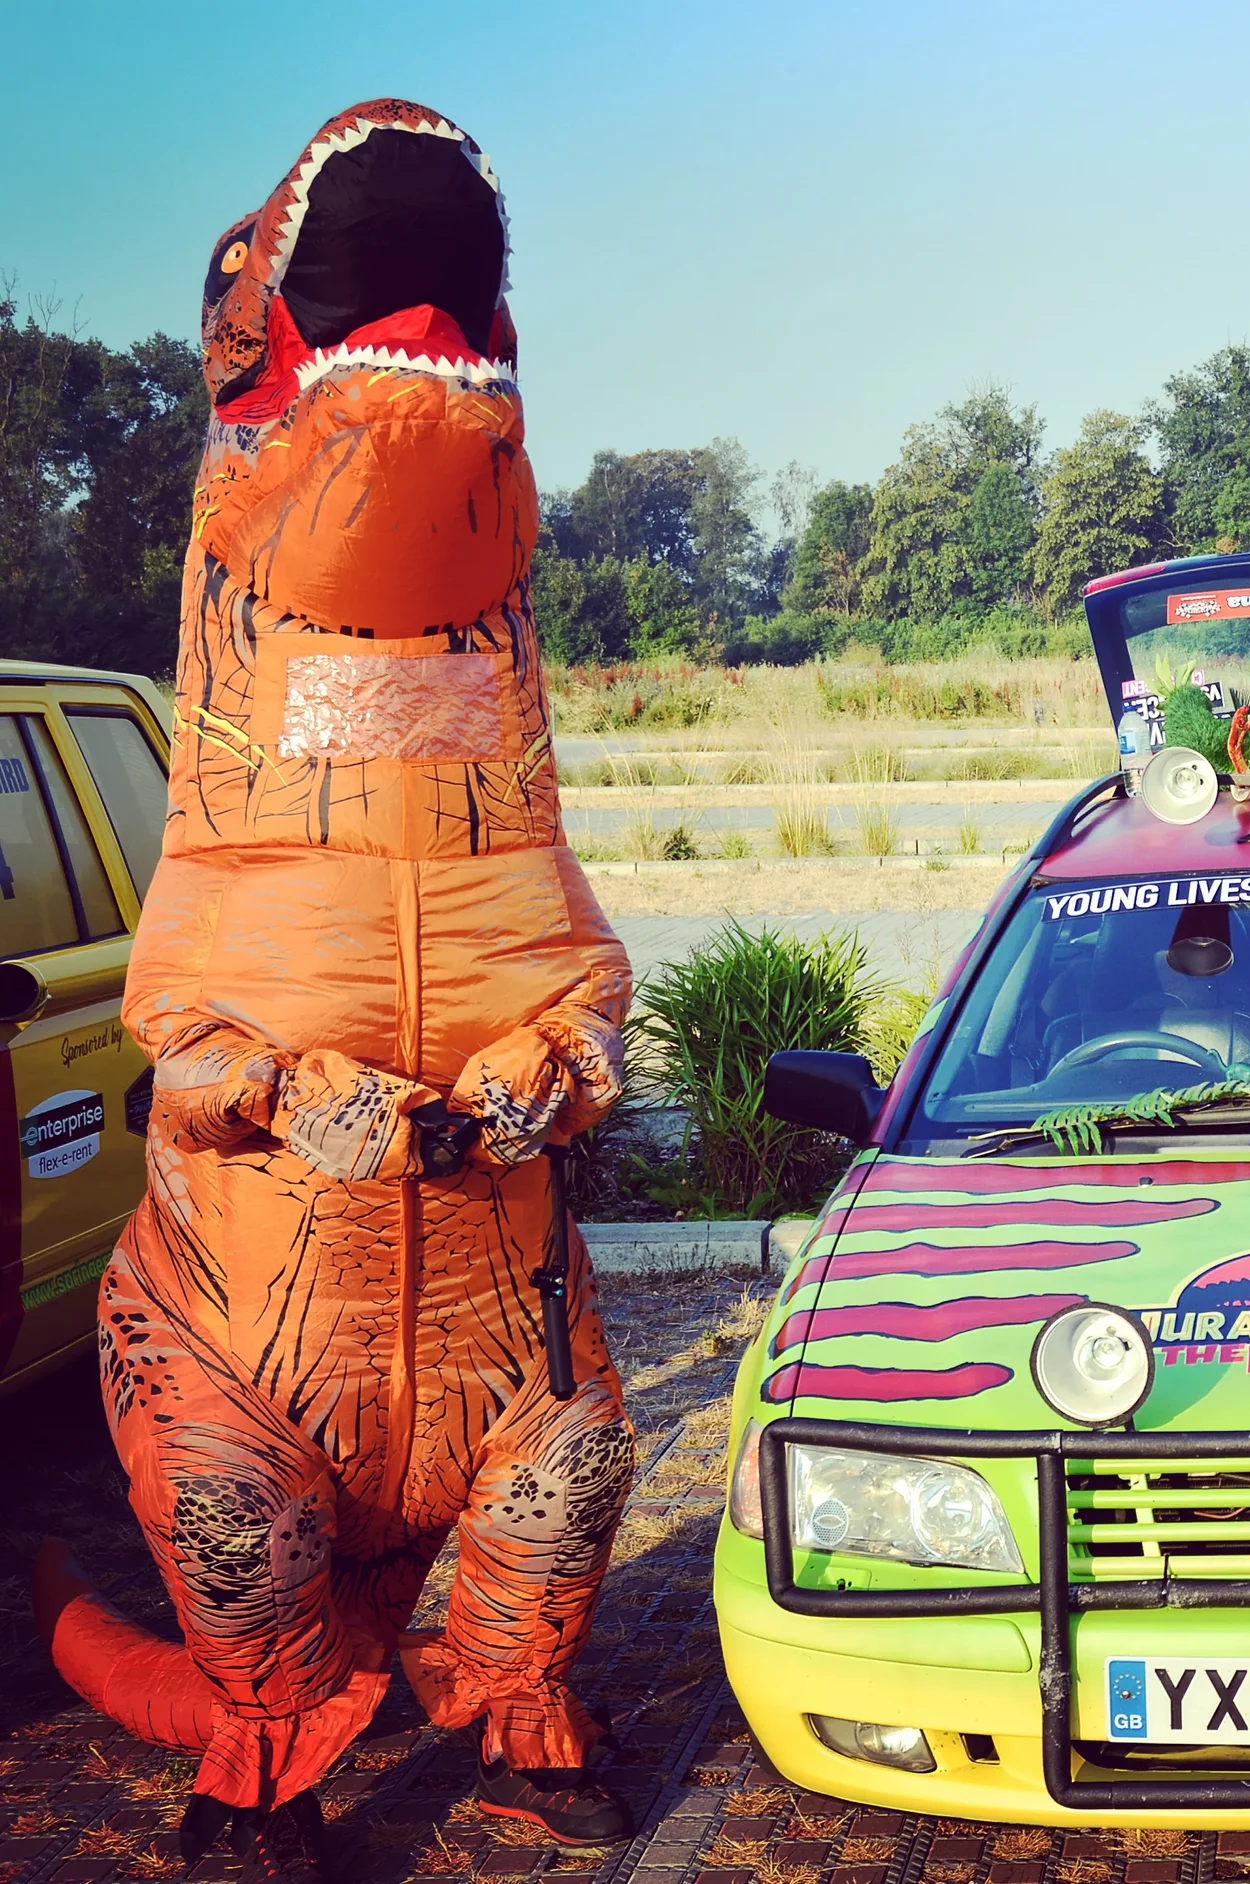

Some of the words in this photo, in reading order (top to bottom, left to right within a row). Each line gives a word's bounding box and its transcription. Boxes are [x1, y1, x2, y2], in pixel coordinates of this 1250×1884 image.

[1048, 884, 1159, 920] YOUNG
[60, 1028, 108, 1069] Sponsored
[111, 1024, 124, 1053] by
[20, 1105, 104, 1146] enterprise
[38, 1142, 93, 1175] flex-e-rent
[1161, 1343, 1246, 1368] THE
[1114, 1714, 1143, 1731] GB
